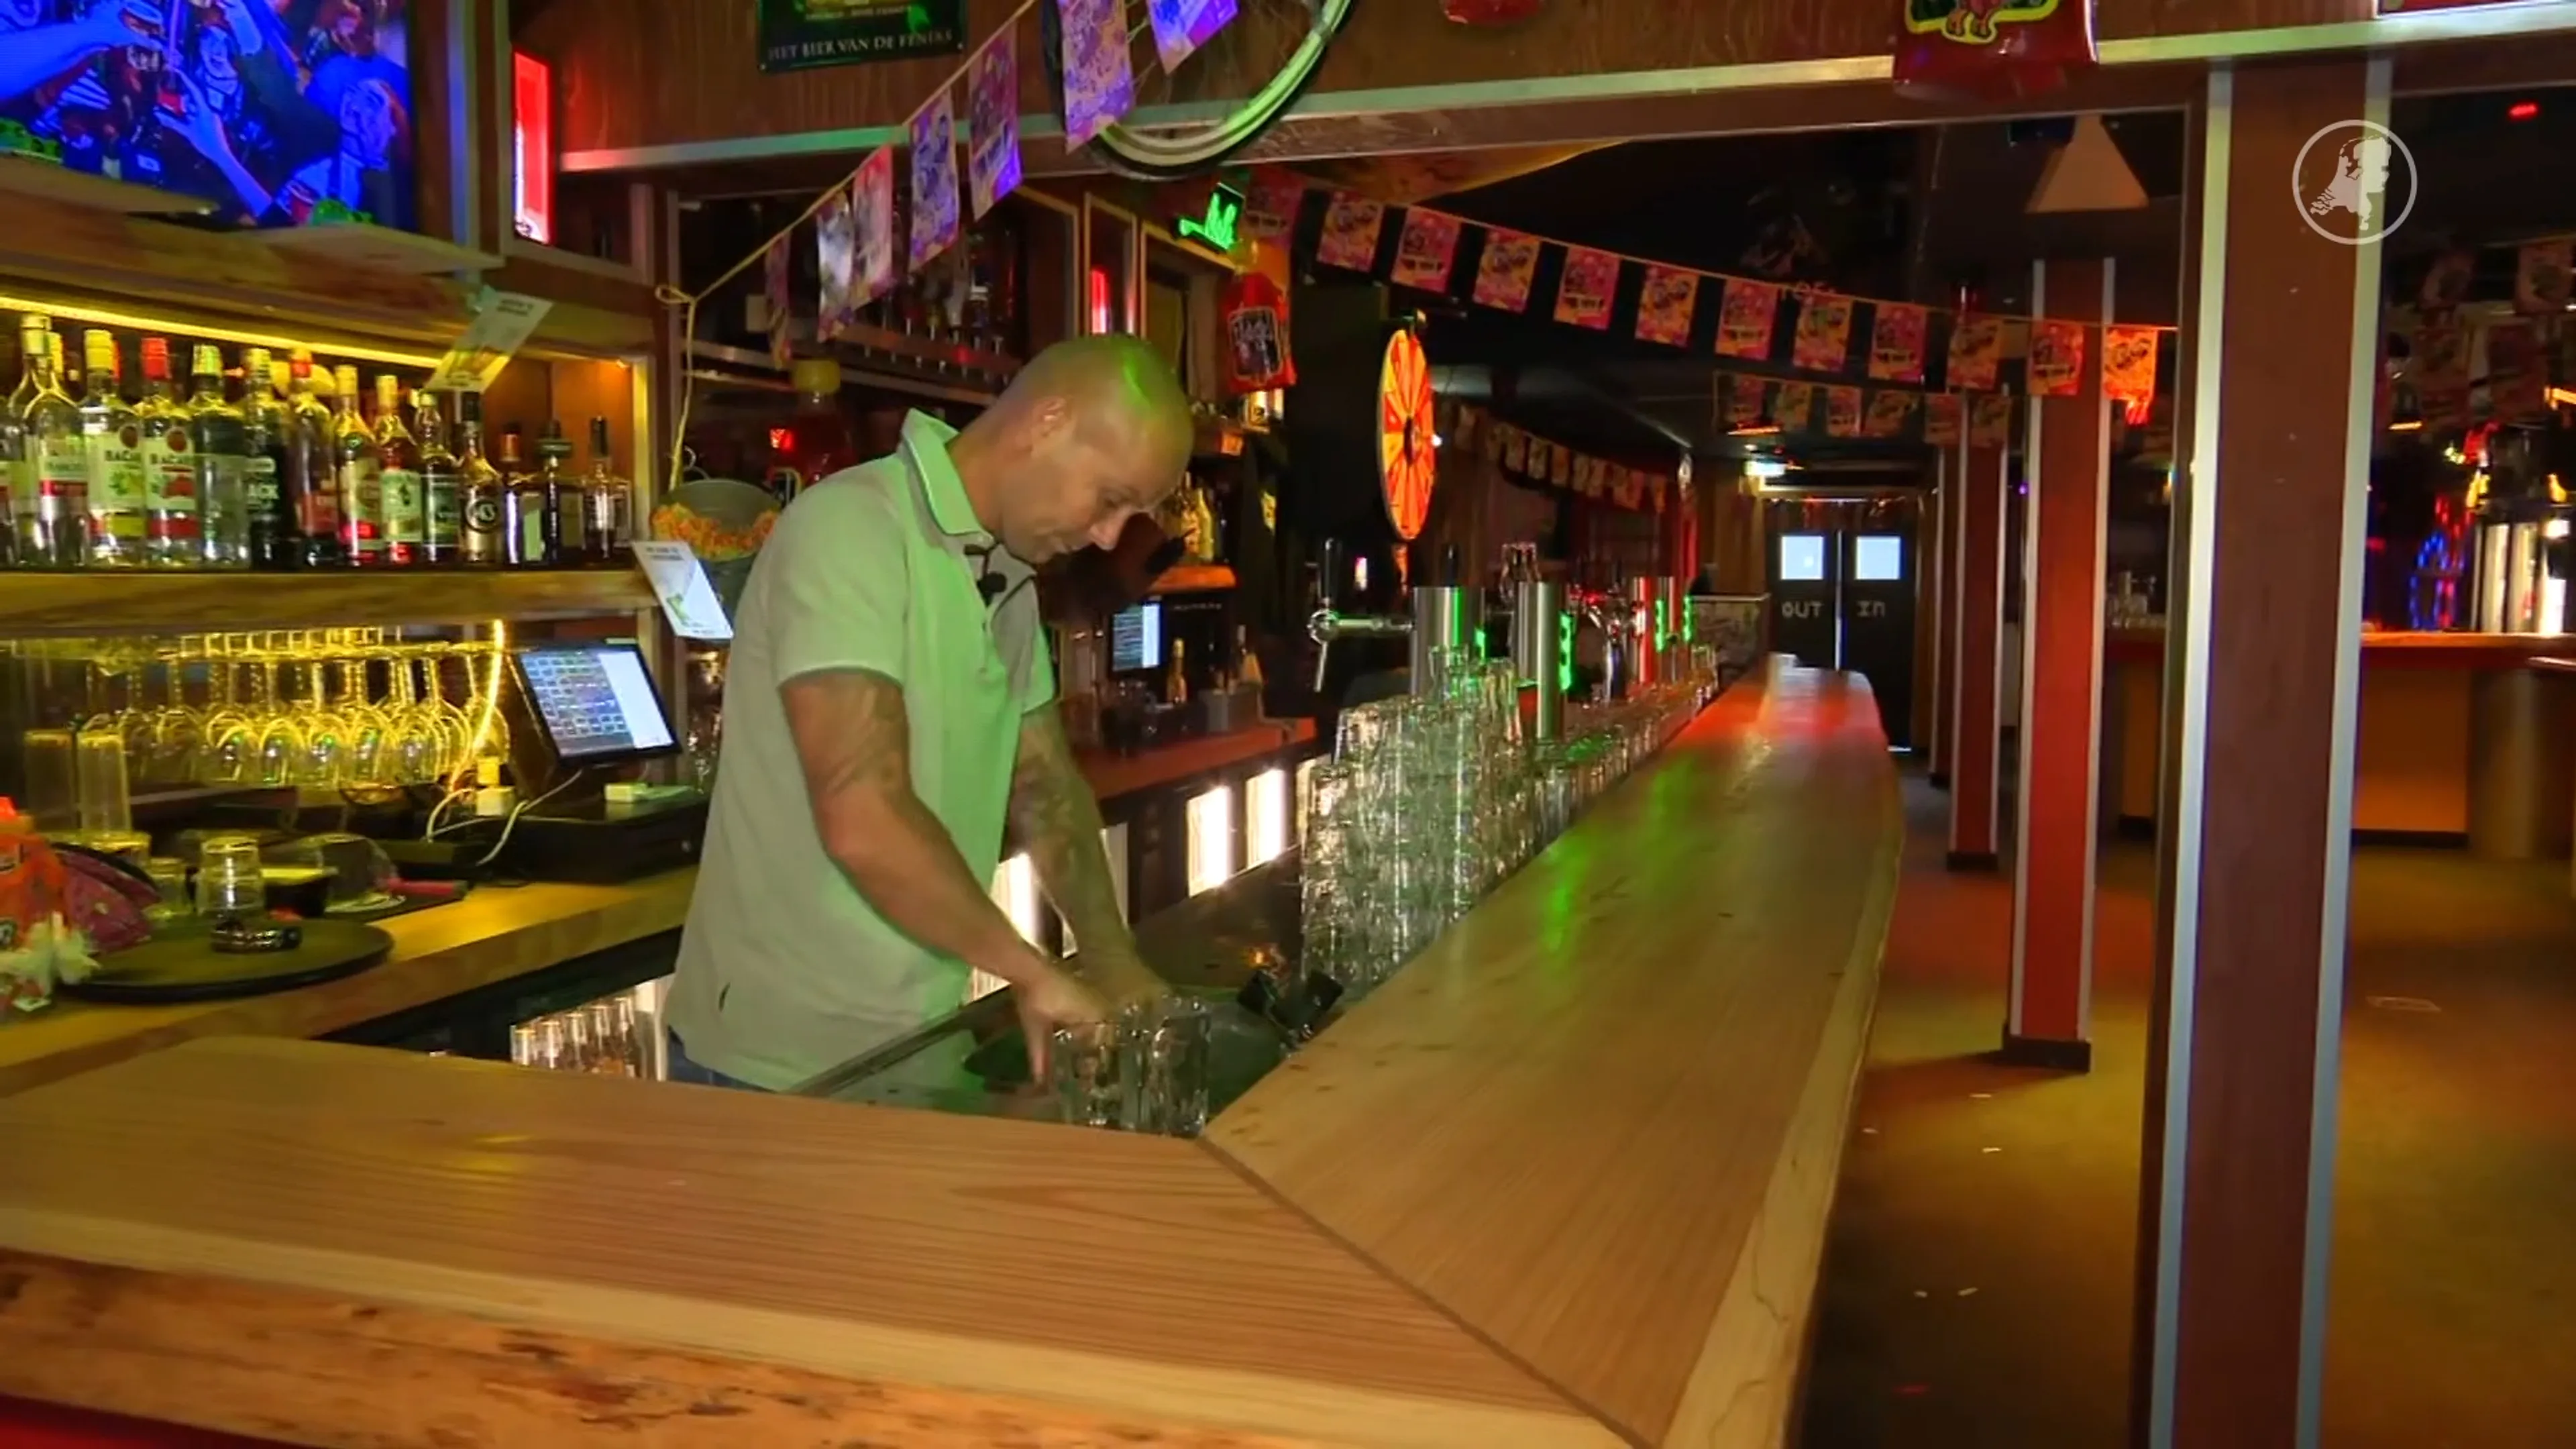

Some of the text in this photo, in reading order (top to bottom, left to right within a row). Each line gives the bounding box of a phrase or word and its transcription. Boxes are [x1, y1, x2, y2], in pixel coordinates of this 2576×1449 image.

[767, 44, 797, 60] HET
[801, 40, 837, 57] BIER
[837, 38, 869, 54] VAN
[873, 35, 895, 49] DE
[1781, 600, 1824, 619] OUT
